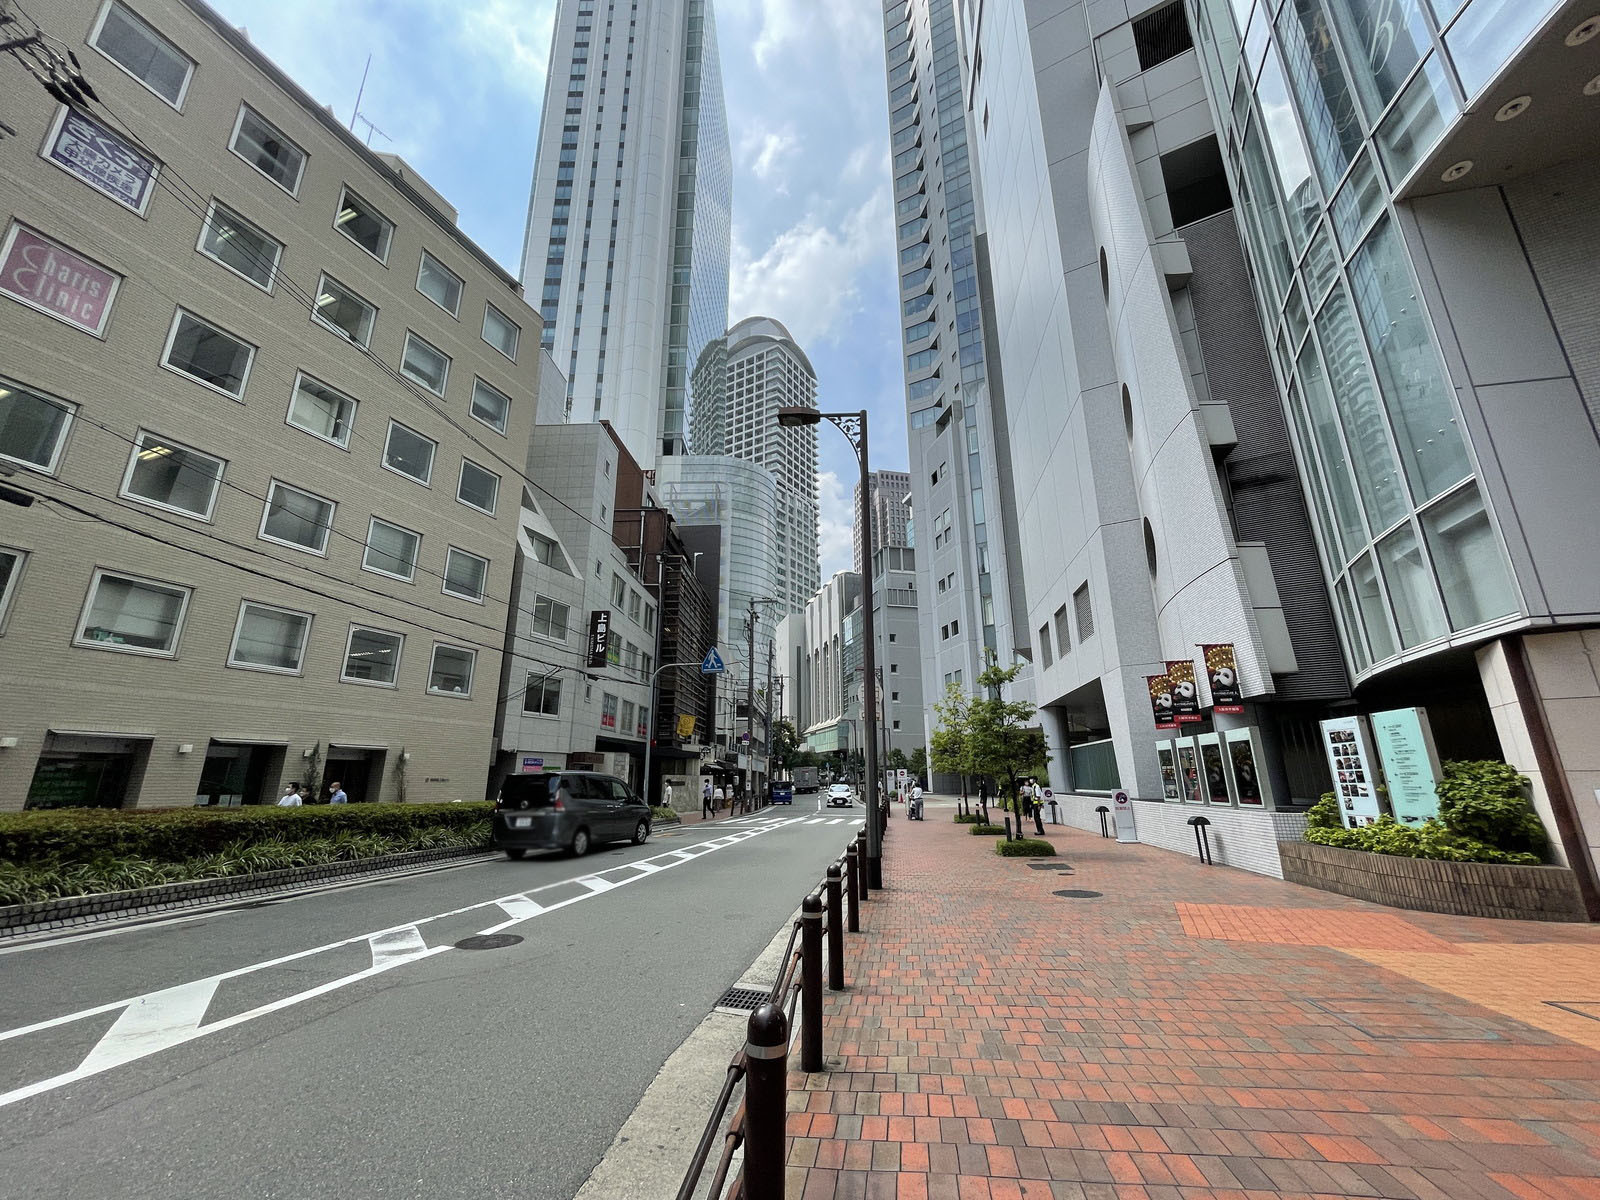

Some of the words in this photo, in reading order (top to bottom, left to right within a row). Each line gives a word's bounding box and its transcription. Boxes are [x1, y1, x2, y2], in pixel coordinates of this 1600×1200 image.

[13, 267, 93, 320] Clinic
[23, 244, 101, 298] Charis
[595, 612, 607, 653] 上島ビル
